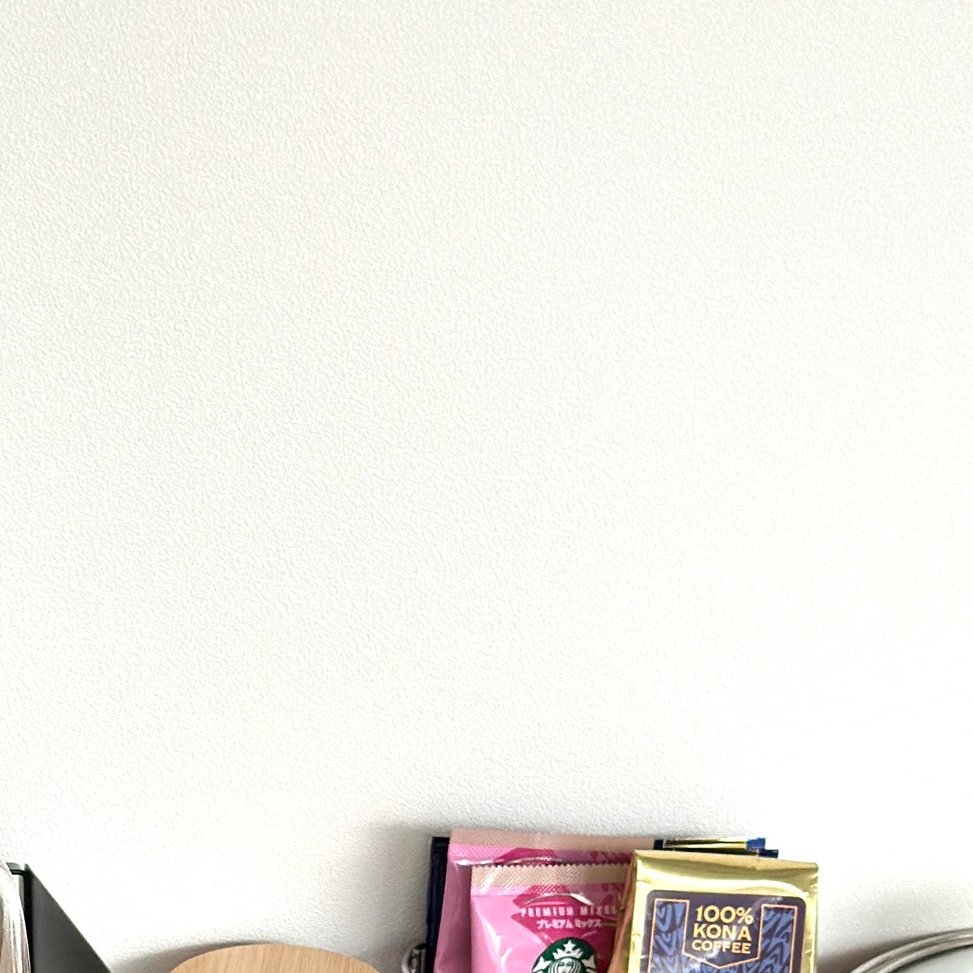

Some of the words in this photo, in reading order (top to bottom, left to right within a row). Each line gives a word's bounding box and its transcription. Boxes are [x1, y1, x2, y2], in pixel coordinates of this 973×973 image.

[521, 906, 574, 917] PREMIUM
[696, 905, 754, 924] 100%
[693, 923, 752, 941] KONA
[692, 940, 751, 954] COFFEE
